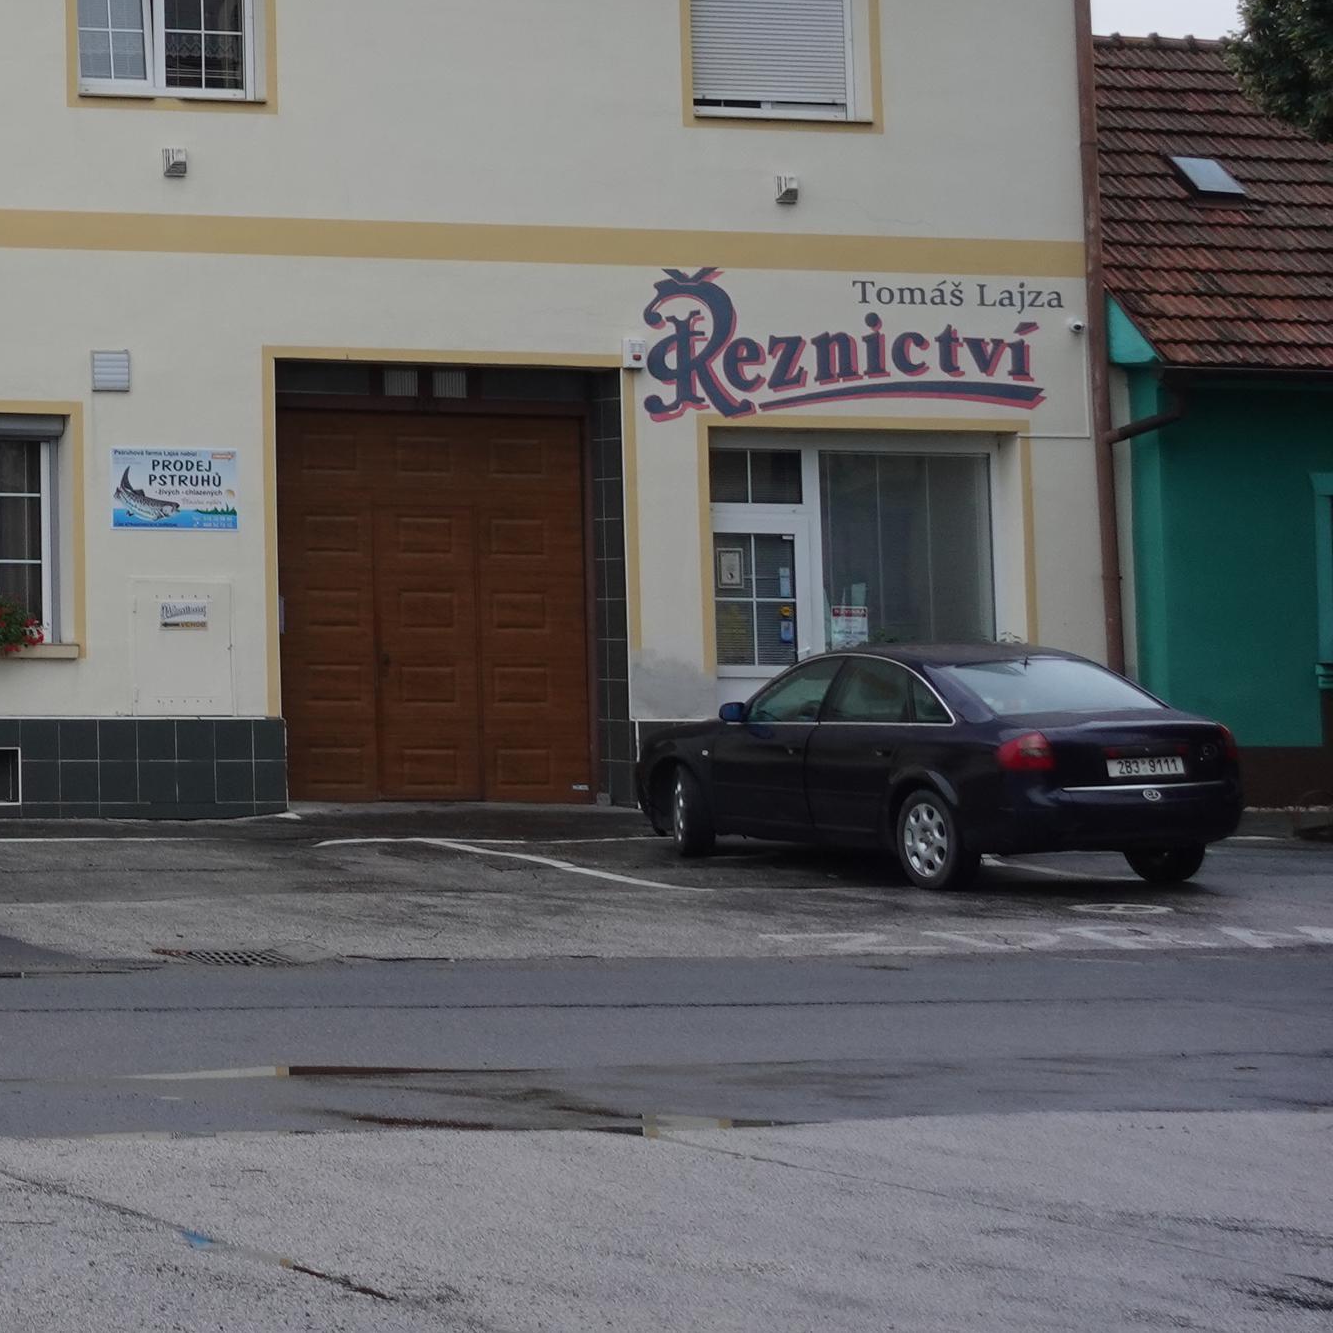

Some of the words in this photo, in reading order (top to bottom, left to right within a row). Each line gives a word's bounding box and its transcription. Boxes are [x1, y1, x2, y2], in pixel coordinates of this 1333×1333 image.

[852, 279, 965, 307] Tomáš
[976, 283, 1065, 312] Lajza
[643, 266, 1040, 424] Řeznictví
[152, 459, 212, 472] PRODEJ
[149, 472, 222, 487] PSTRUHŮ
[1117, 759, 1140, 775] 2B3
[1148, 758, 1179, 773] 9111
